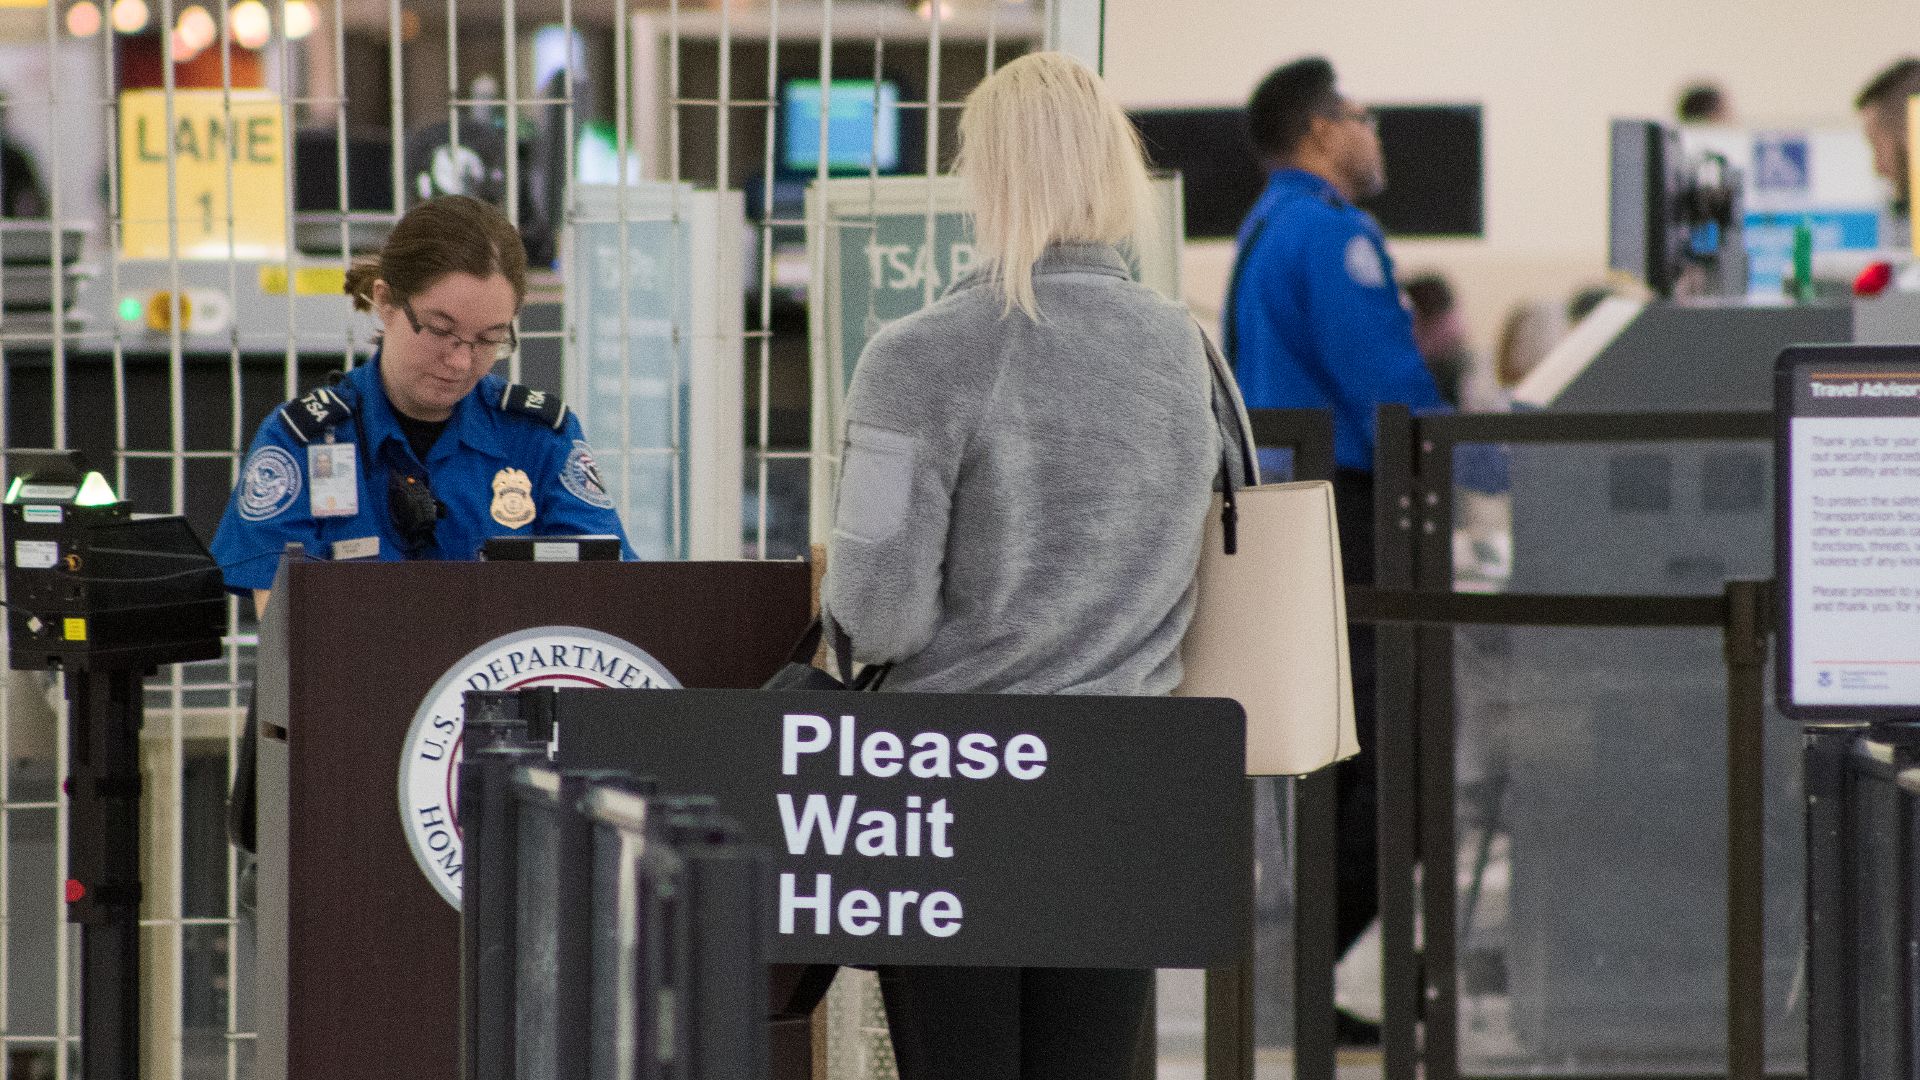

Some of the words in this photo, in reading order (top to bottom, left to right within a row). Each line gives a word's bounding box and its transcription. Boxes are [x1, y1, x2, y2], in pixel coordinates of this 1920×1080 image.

[138, 116, 274, 163] LANE
[198, 191, 213, 233] 1
[864, 243, 940, 288] TSA
[950, 243, 981, 285] P
[301, 392, 330, 422] TSA
[1811, 381, 1859, 397] Travel
[420, 714, 460, 763] U.S.
[782, 714, 1048, 780] Please
[419, 805, 463, 889] HOM
[776, 793, 954, 857] Wait
[779, 872, 963, 937] Here
